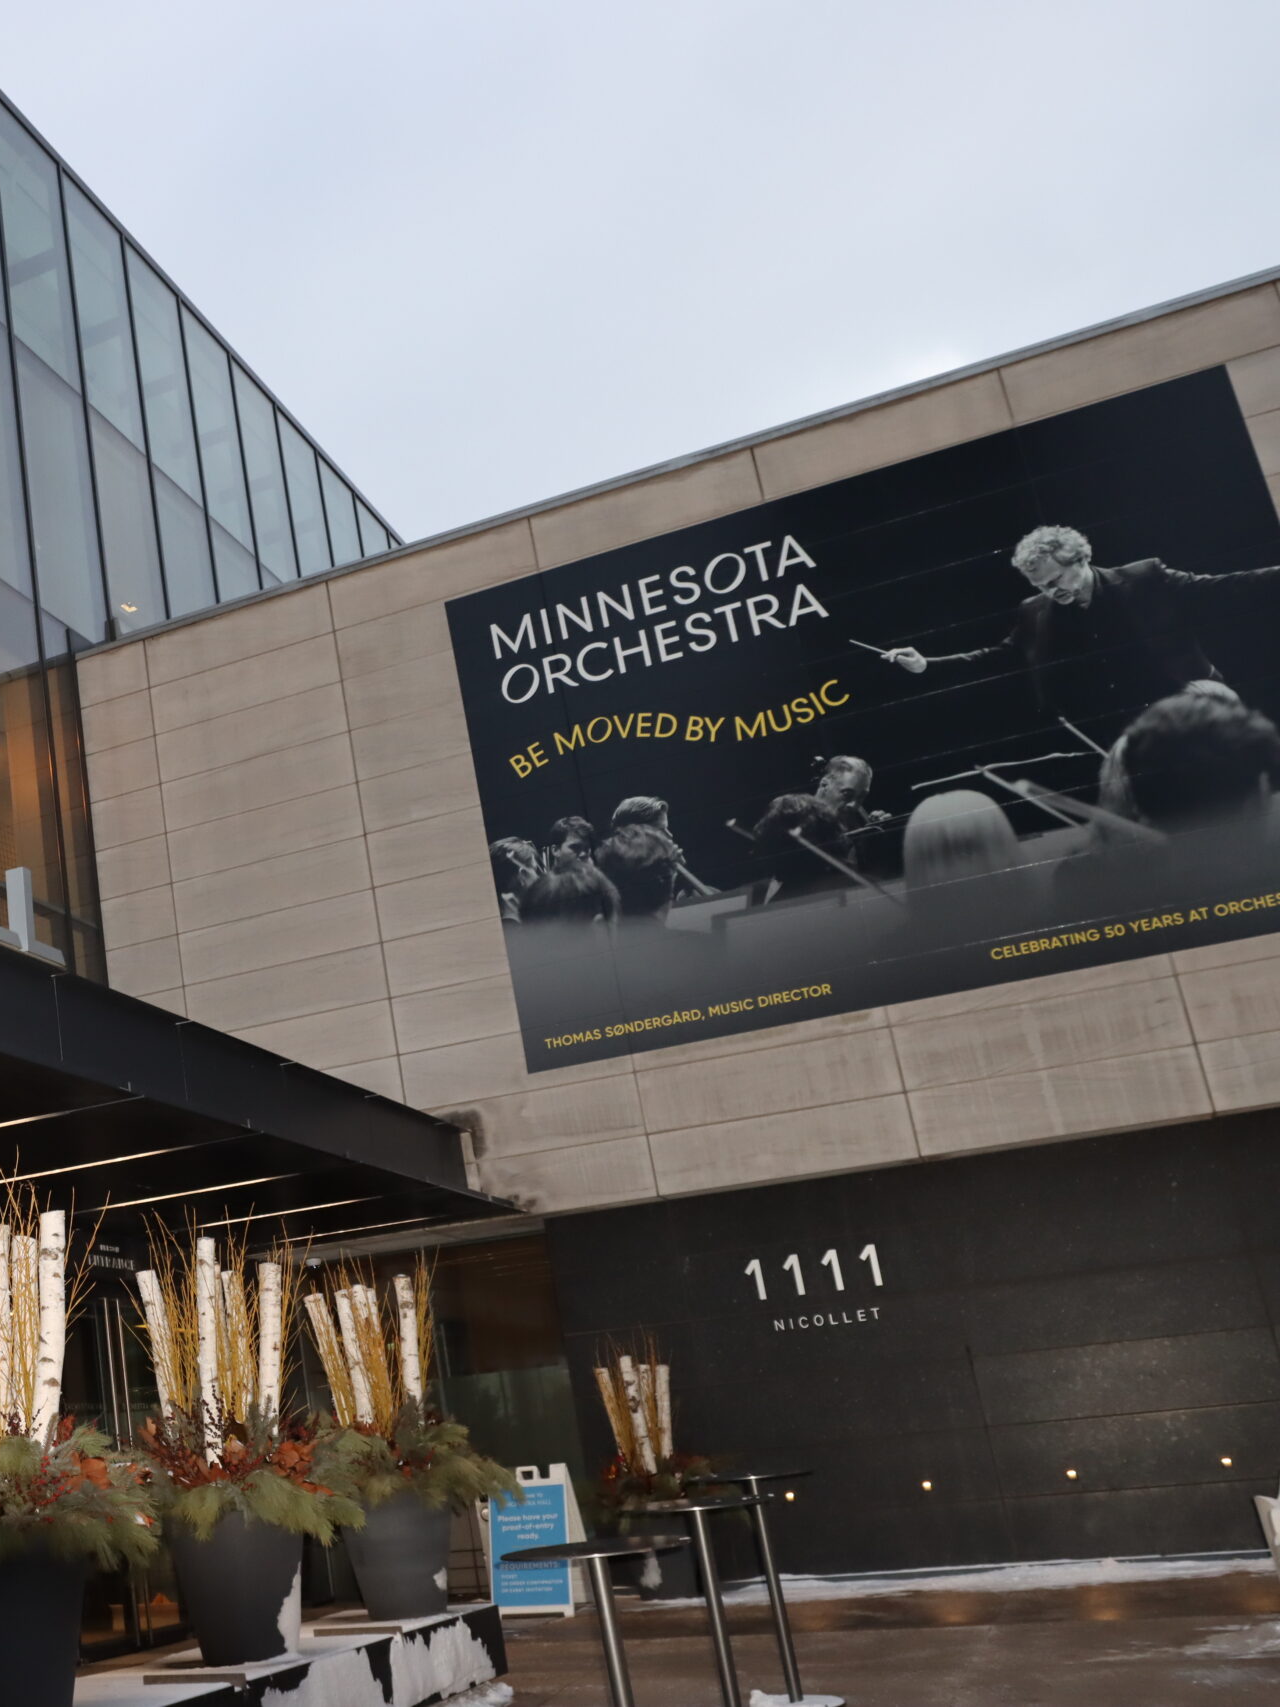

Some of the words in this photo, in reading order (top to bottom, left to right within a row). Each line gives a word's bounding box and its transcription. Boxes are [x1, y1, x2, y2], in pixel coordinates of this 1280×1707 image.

[489, 533, 817, 660] MINNESOTA
[500, 583, 830, 704] ORCHESTRA
[508, 741, 550, 779] BE
[553, 711, 679, 756] MOVED
[684, 714, 725, 743] BY
[734, 678, 851, 742] MUSIC
[989, 929, 1102, 961] CELEBRATING
[1104, 923, 1127, 939] 50
[1129, 911, 1185, 934] YEARS
[1188, 906, 1210, 923] AT
[544, 1028, 603, 1049] THOMAS
[605, 1008, 706, 1039] SØNDERGÅRD,
[708, 997, 755, 1018] MUSIC
[757, 983, 833, 1009] DIRECTOR
[743, 1243, 884, 1301] 1111
[773, 1307, 881, 1332] NICOLLET
[502, 1523, 554, 1532] proof-of-entry
[522, 1513, 541, 1521] have
[542, 1513, 558, 1521] your
